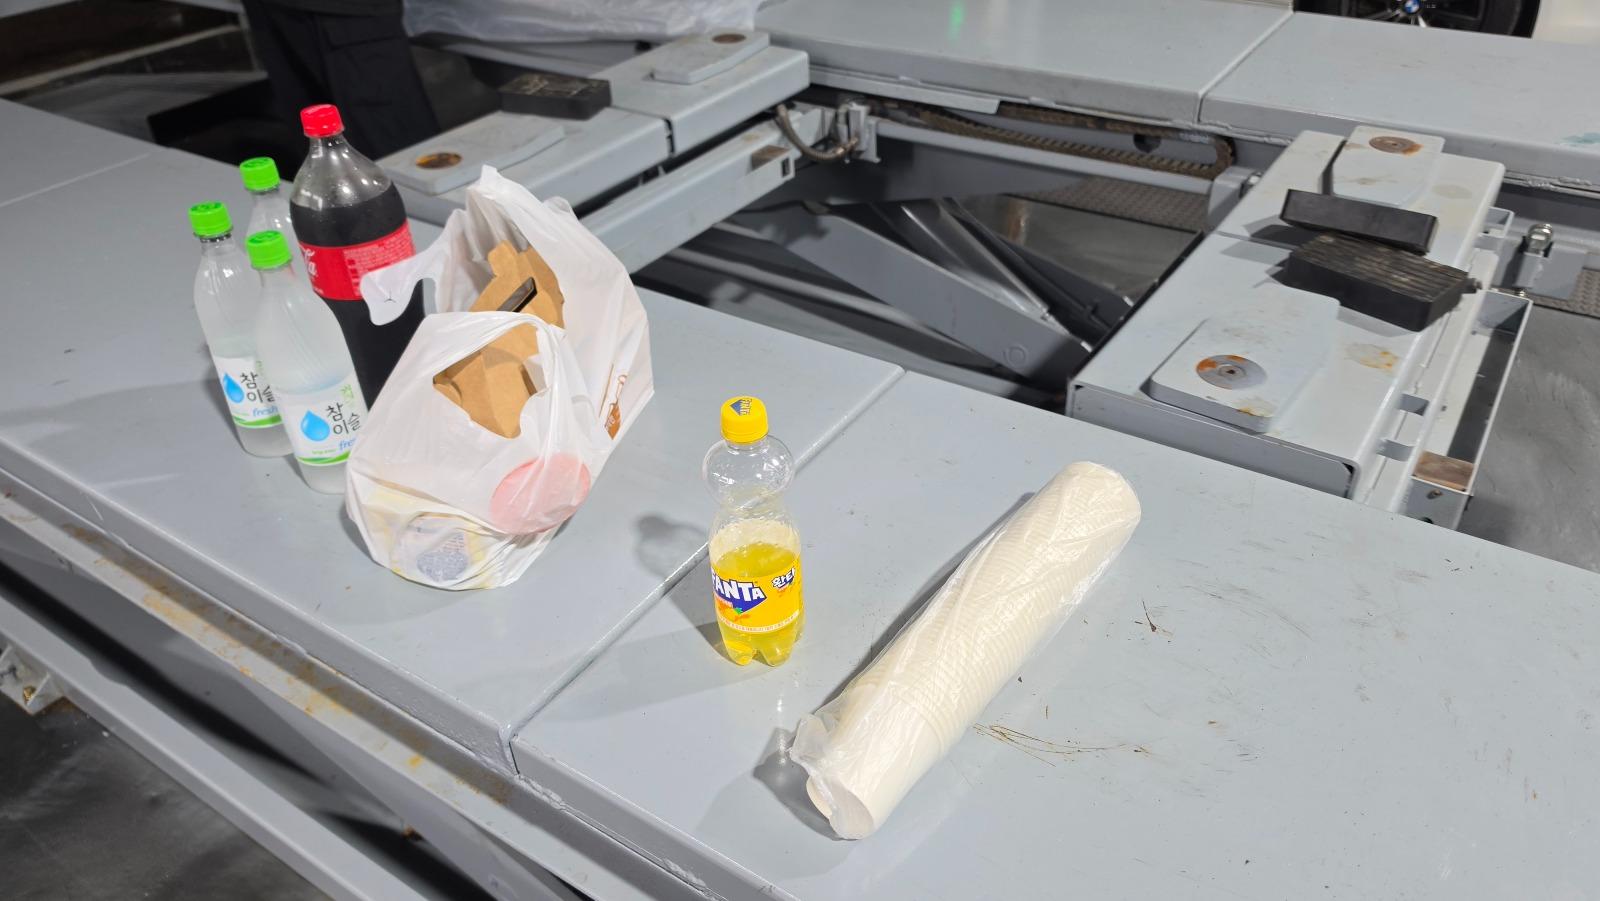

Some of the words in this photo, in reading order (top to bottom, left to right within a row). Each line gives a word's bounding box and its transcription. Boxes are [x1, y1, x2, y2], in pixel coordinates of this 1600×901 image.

[240, 371, 258, 389] 참
[325, 402, 344, 422] 참
[333, 412, 362, 435] 이슬
